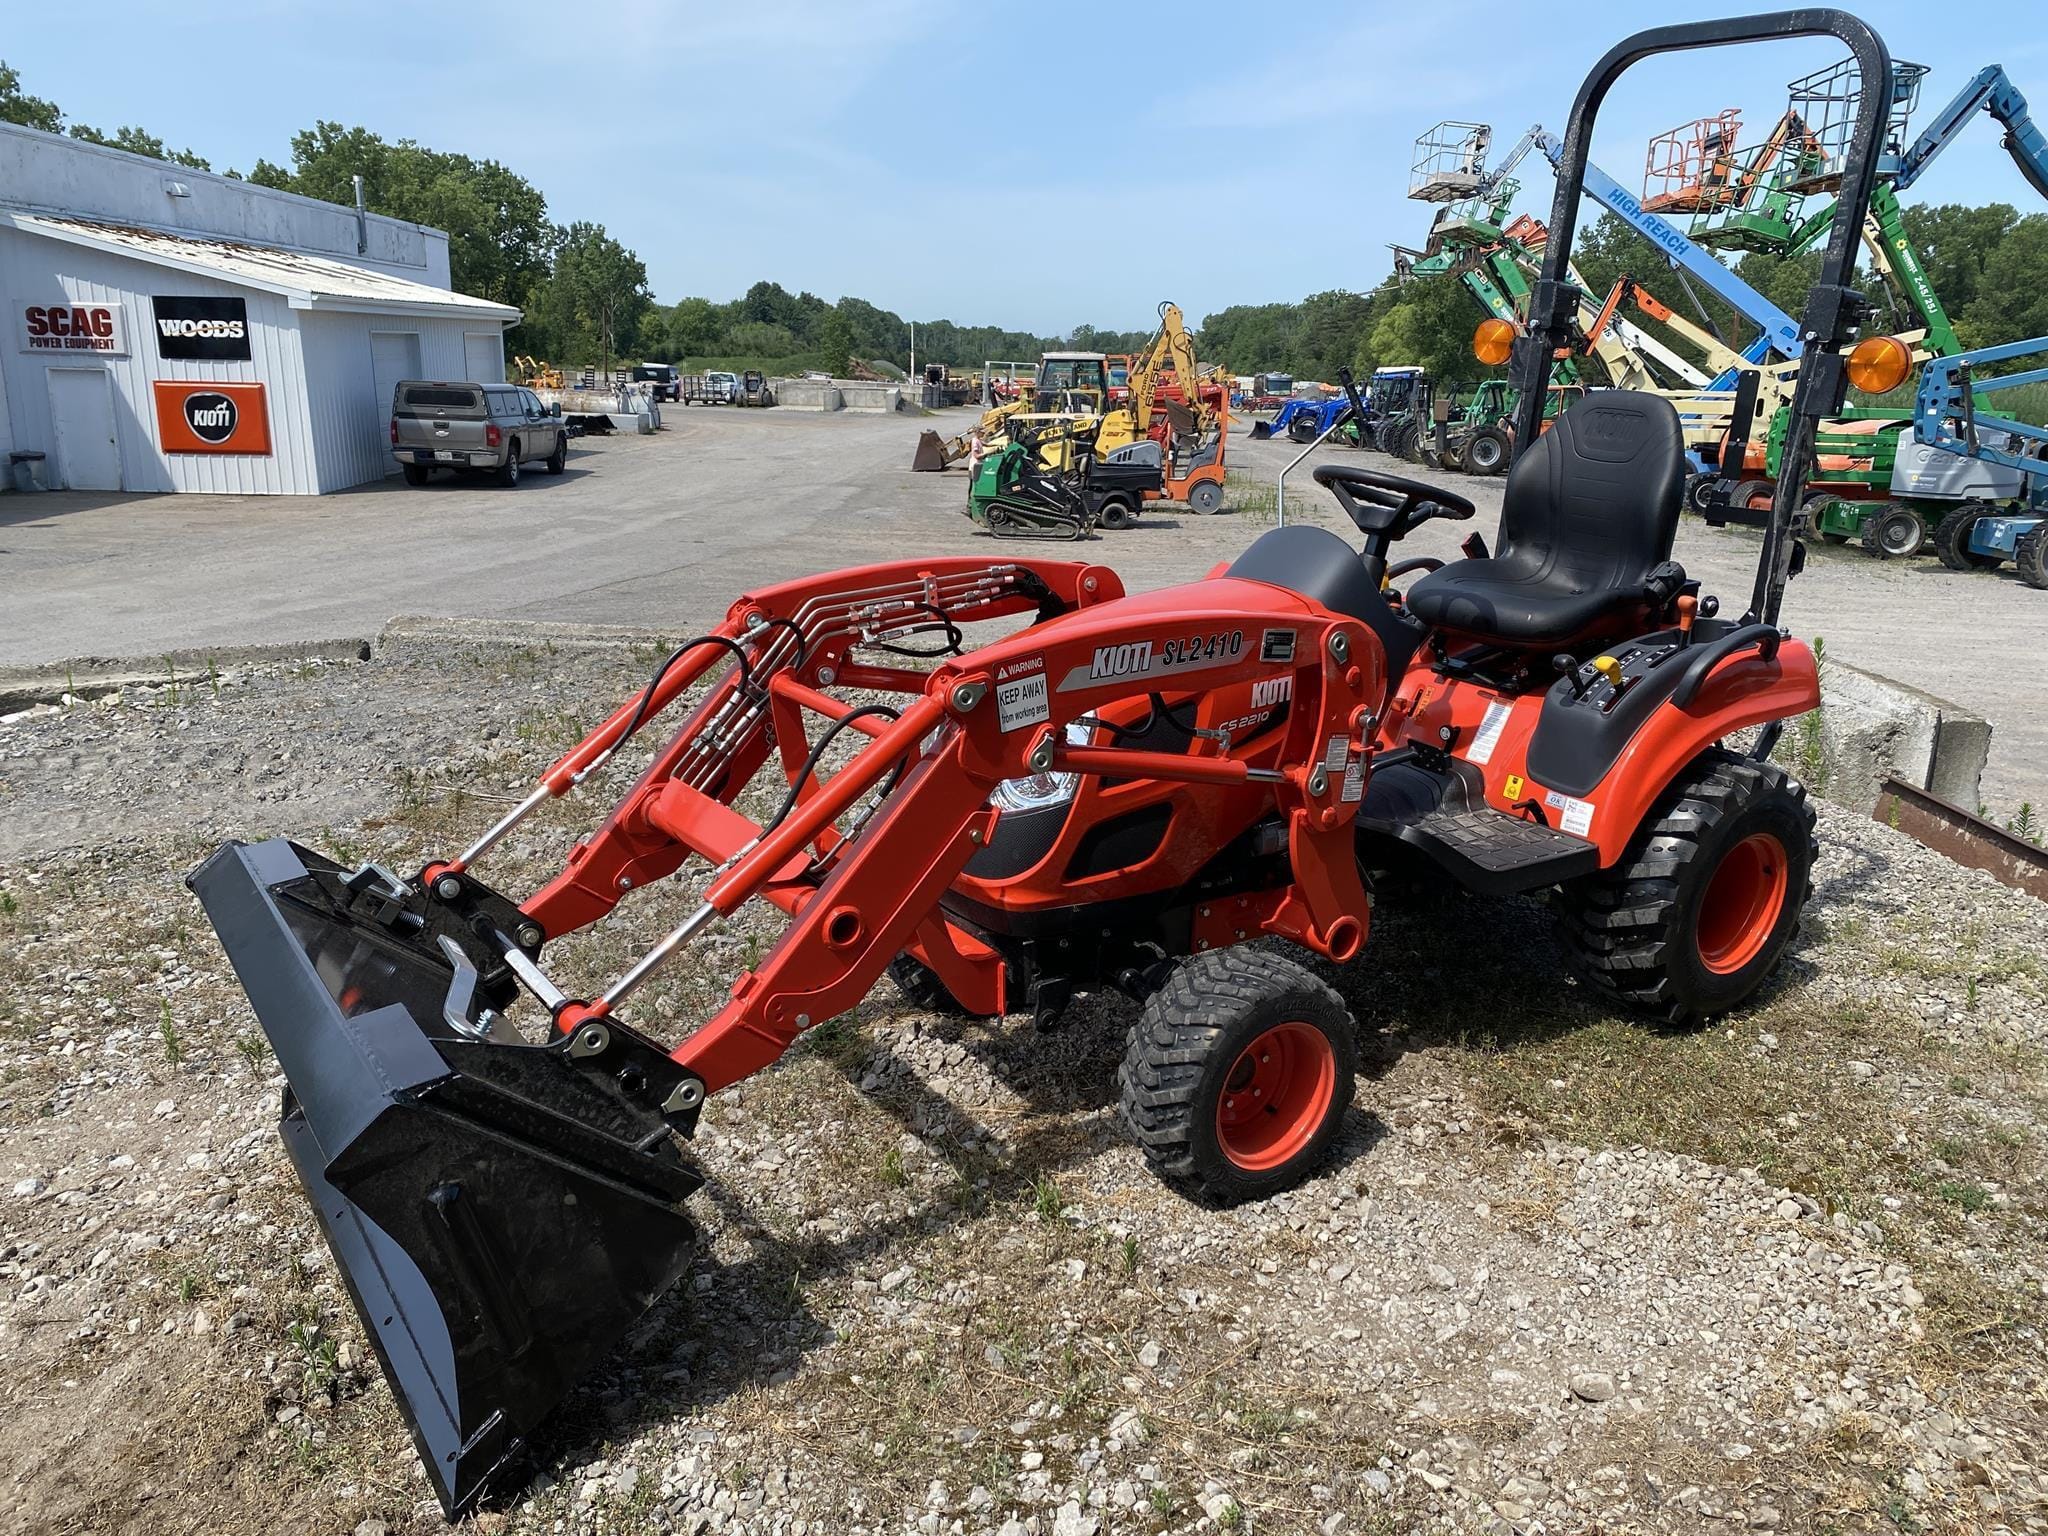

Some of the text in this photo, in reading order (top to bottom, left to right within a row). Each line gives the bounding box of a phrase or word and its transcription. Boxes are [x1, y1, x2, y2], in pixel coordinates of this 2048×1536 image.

[1608, 189, 1690, 255] HIGH REACH
[25, 306, 113, 337] SCAG
[158, 319, 244, 338] WOODS
[29, 337, 115, 350] POWER EQUIPMENT
[1141, 373, 1149, 396] FORD
[1145, 360, 1161, 407] 655E
[193, 409, 230, 427] KIOTI
[1008, 657, 1043, 675] WARNING
[1090, 641, 1152, 680] KIOTI
[1162, 630, 1243, 666] SL2410
[999, 680, 1044, 706] KEEP AWAY
[1251, 675, 1293, 709] KIOTI
[1002, 703, 1047, 724] from working area
[1218, 711, 1270, 731] CS2210
